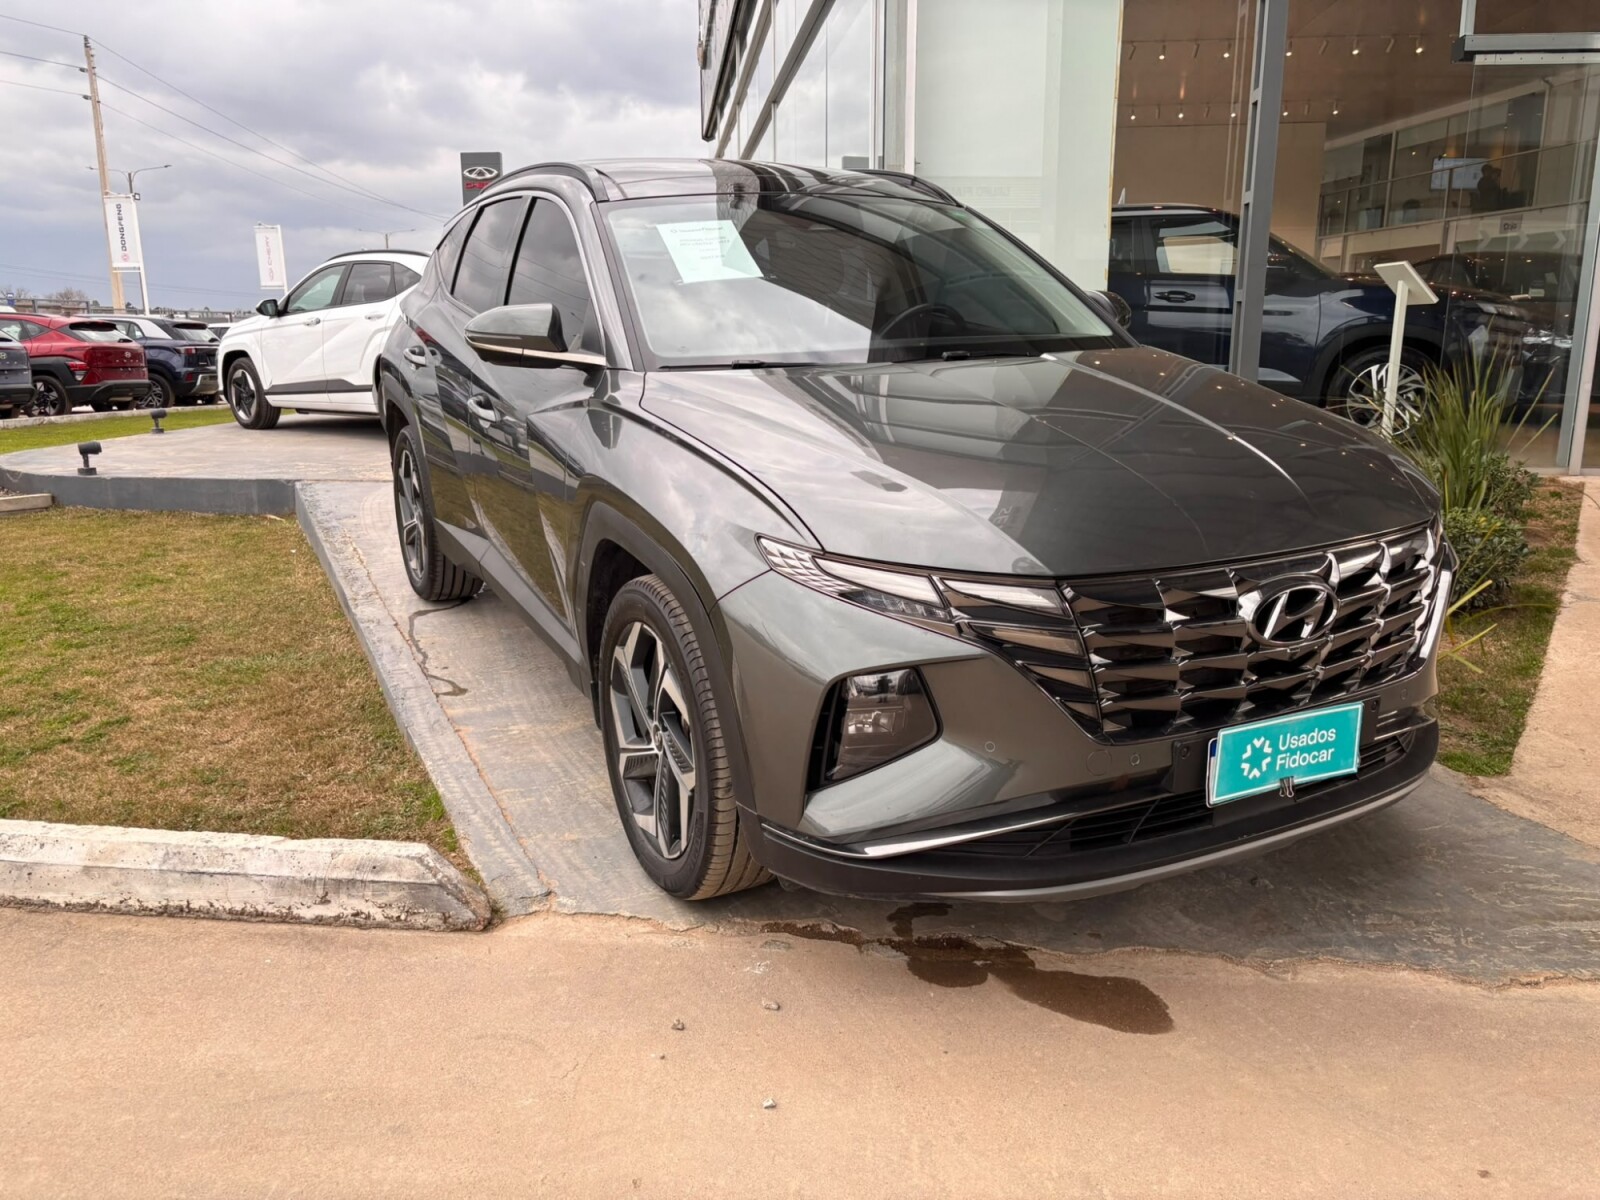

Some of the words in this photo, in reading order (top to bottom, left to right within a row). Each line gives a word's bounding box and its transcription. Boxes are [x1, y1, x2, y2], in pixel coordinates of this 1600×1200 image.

[116, 203, 127, 252] DONGFENG
[1278, 727, 1337, 751] Usados
[1276, 747, 1335, 772] Fidocar
